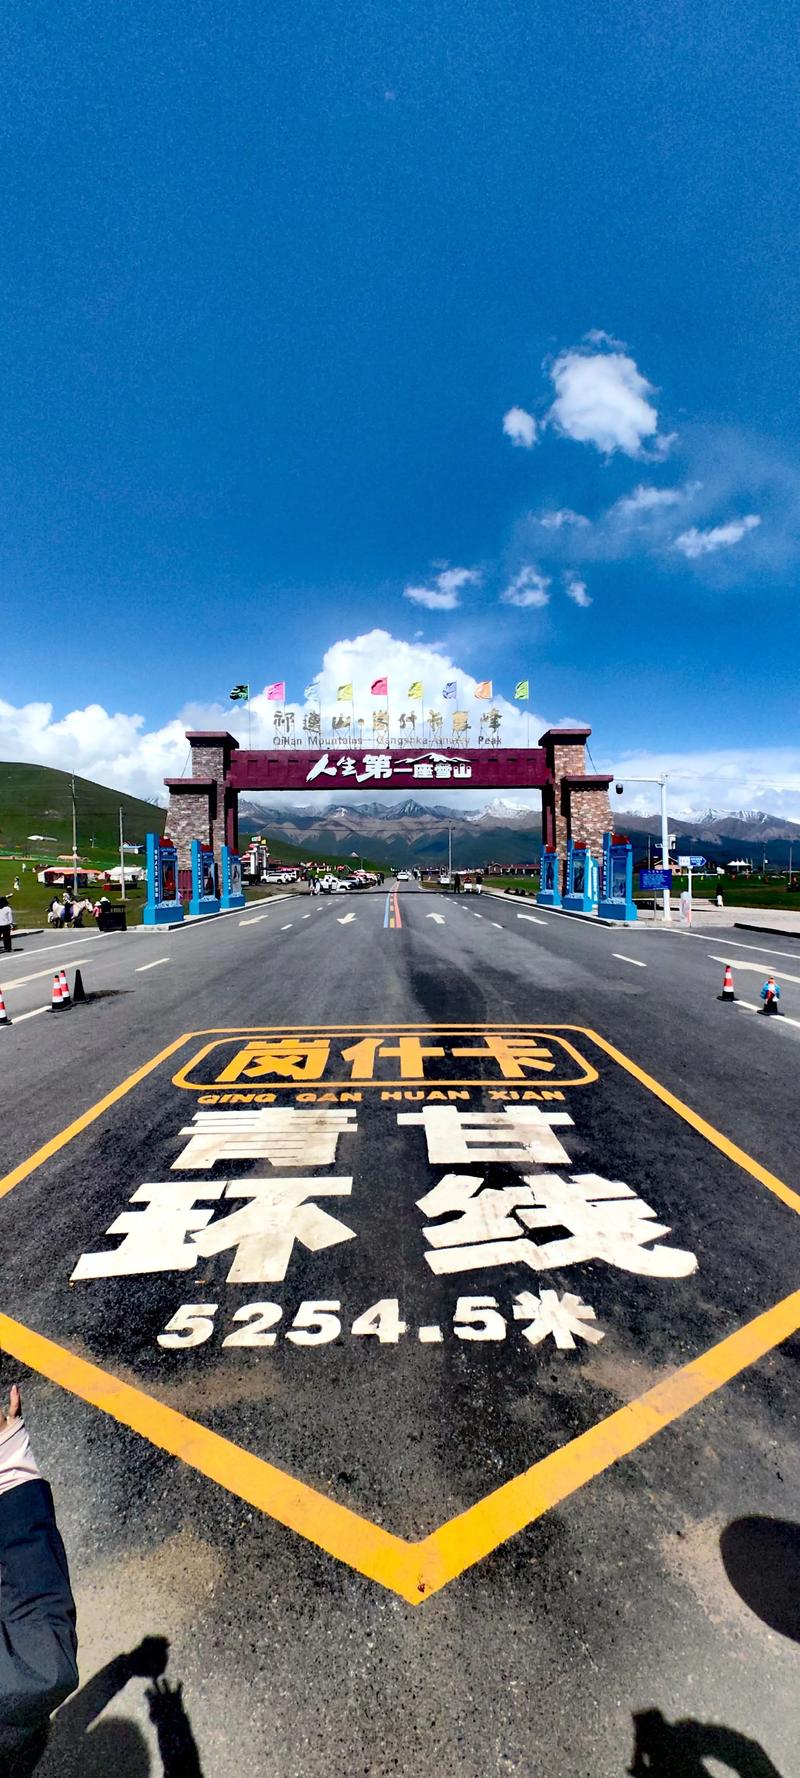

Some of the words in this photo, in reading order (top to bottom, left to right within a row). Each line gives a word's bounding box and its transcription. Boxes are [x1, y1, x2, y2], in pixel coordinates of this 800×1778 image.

[478, 736, 502, 745] Peak
[306, 754, 472, 782] 人生第一座雪山
[215, 1035, 556, 1083] 岗什卡
[196, 1093, 277, 1104] QING
[295, 1092, 363, 1103] GAN
[379, 1090, 471, 1101] HUAN
[488, 1090, 566, 1101] XIAN
[157, 1289, 605, 1349] 5254.5米
